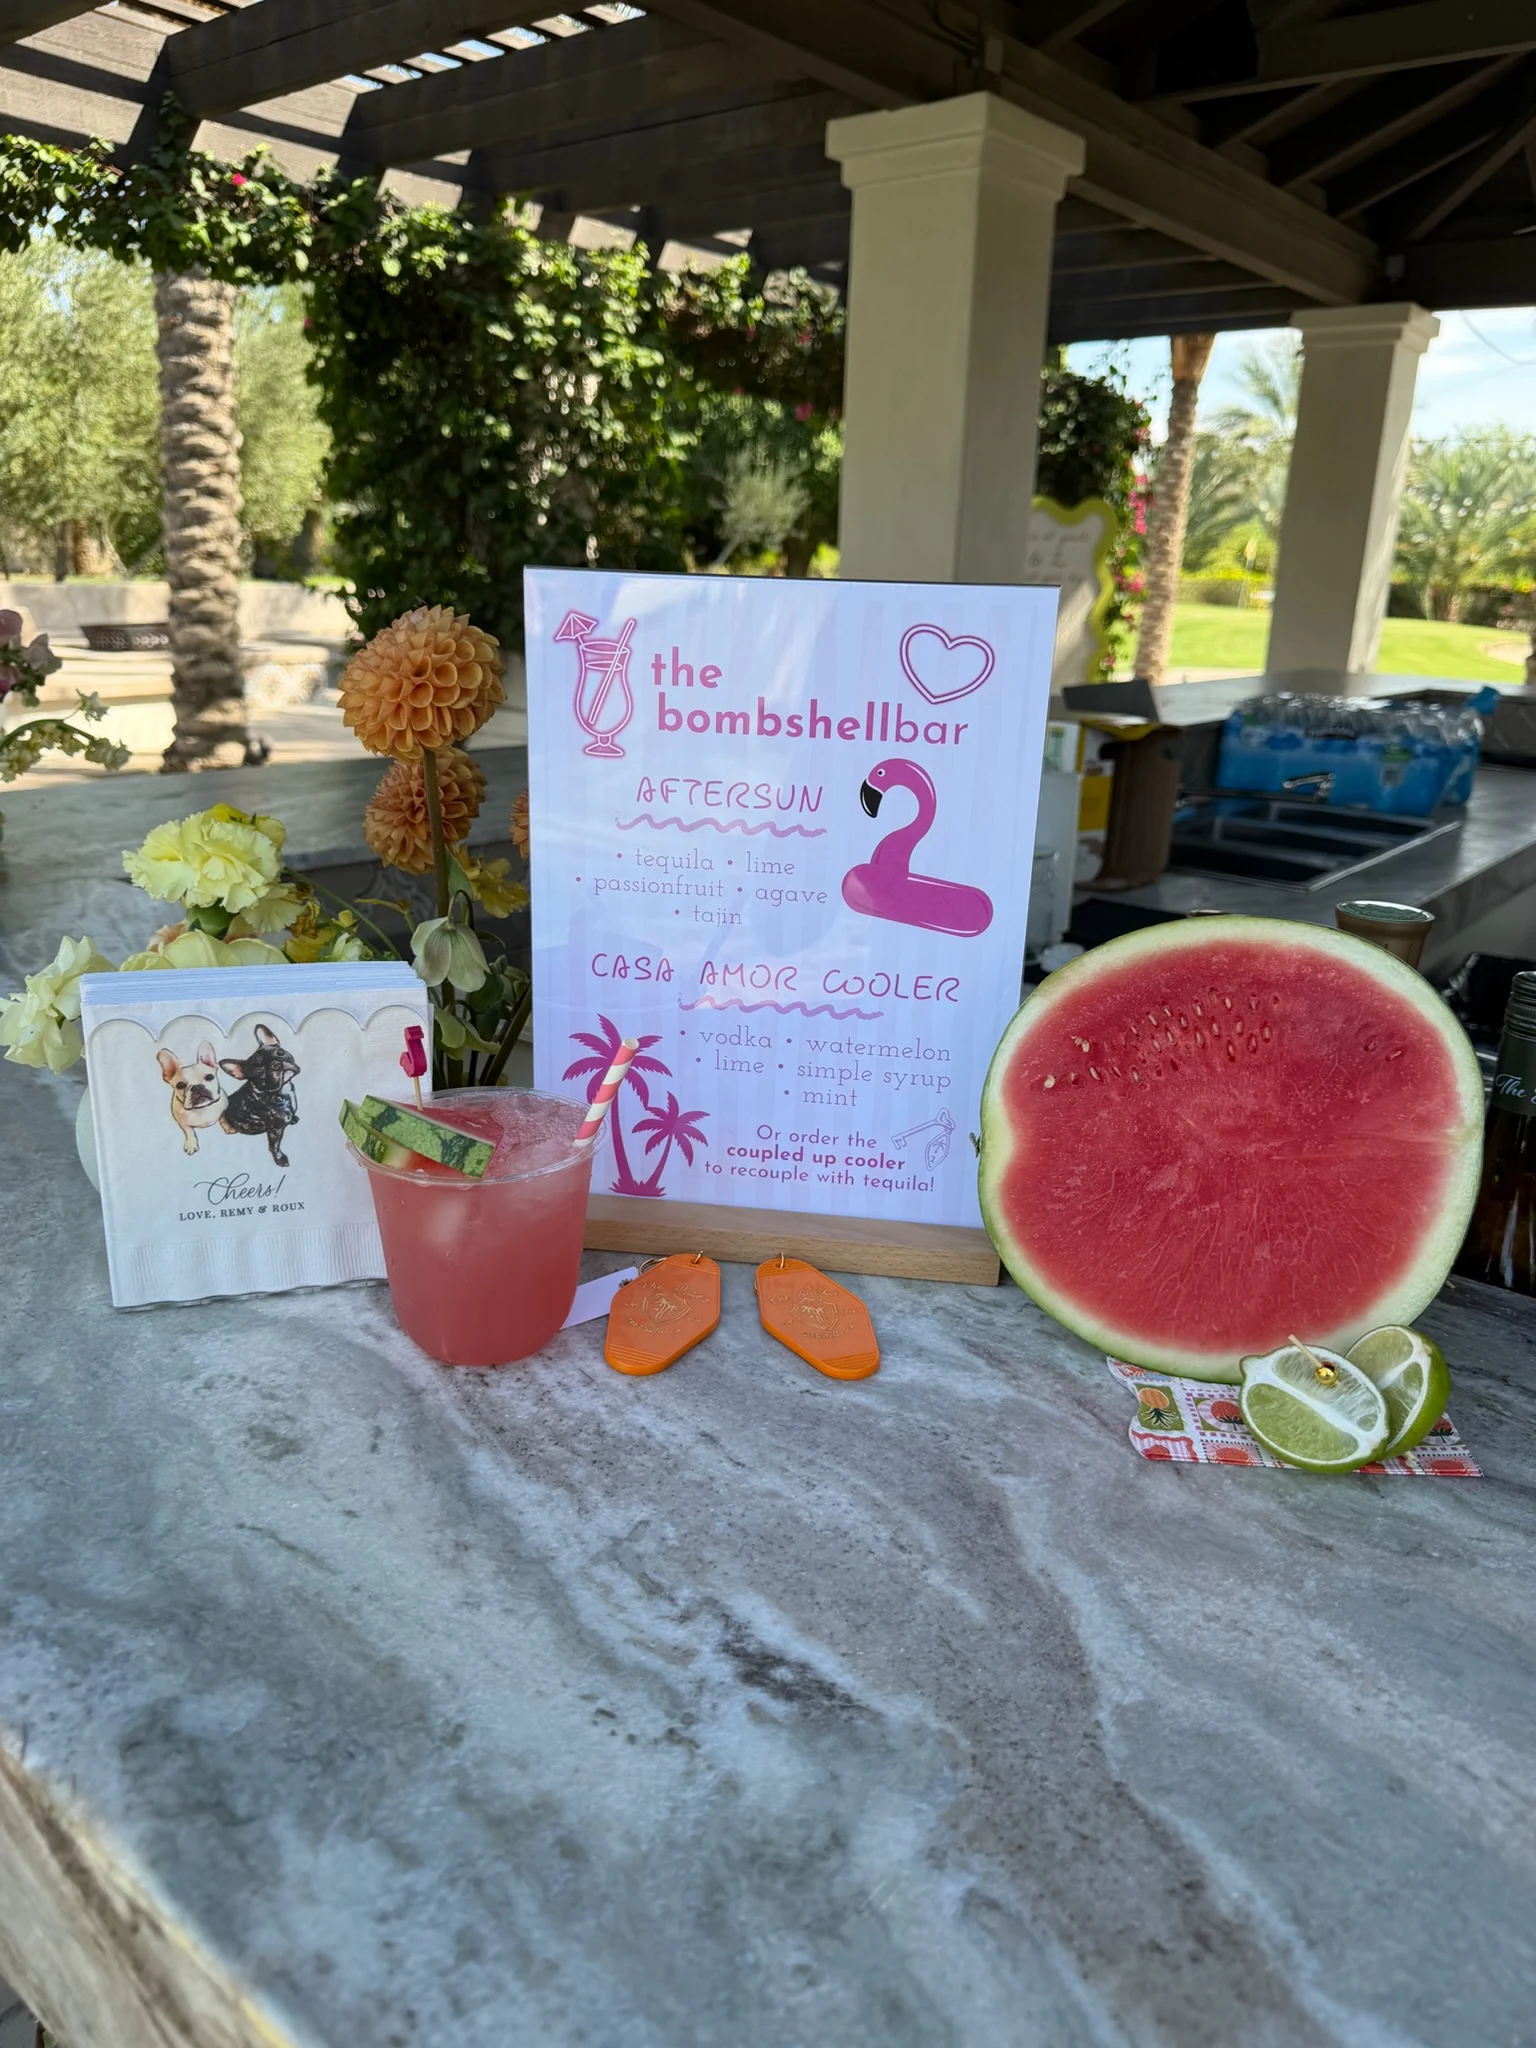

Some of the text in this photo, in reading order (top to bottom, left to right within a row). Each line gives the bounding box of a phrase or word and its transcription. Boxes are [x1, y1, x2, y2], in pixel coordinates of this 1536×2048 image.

[651, 646, 722, 689] the
[636, 776, 823, 812] AFTERSUN
[635, 848, 795, 876] tequila lime
[594, 874, 828, 906] passionfruit agave
[693, 905, 743, 927] tajin
[591, 953, 960, 1003] CASA AMOR COOLER
[700, 1026, 951, 1062] vodka watermelon
[715, 1050, 951, 1094] lime simple syrup
[1496, 1074, 1527, 1097] The
[803, 1088, 858, 1107] mint
[757, 1124, 877, 1148] Or order the
[727, 1144, 905, 1171] coupled up cooler
[193, 1172, 286, 1206] Cheers!
[705, 1160, 935, 1193] to recouple with tequila!
[180, 1201, 305, 1221] LOVE, REMY & ROUX
